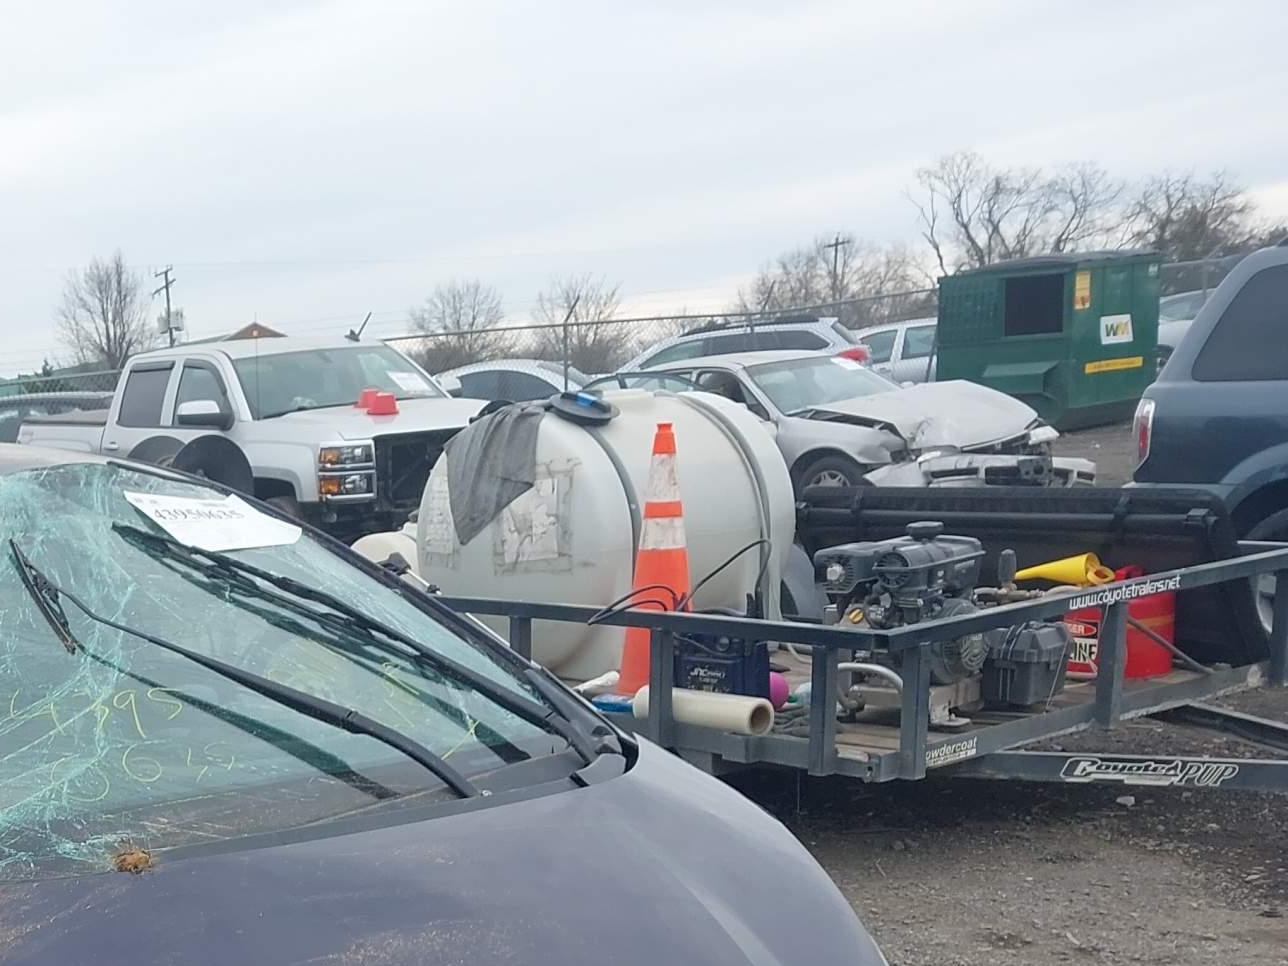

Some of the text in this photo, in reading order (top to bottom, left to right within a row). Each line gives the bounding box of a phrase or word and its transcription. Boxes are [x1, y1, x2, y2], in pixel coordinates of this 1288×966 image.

[1105, 320, 1129, 337] WM
[1069, 574, 1181, 610] www.coyotetrailers.net
[925, 735, 978, 760] owdercoat
[1174, 762, 1240, 787] PUP
